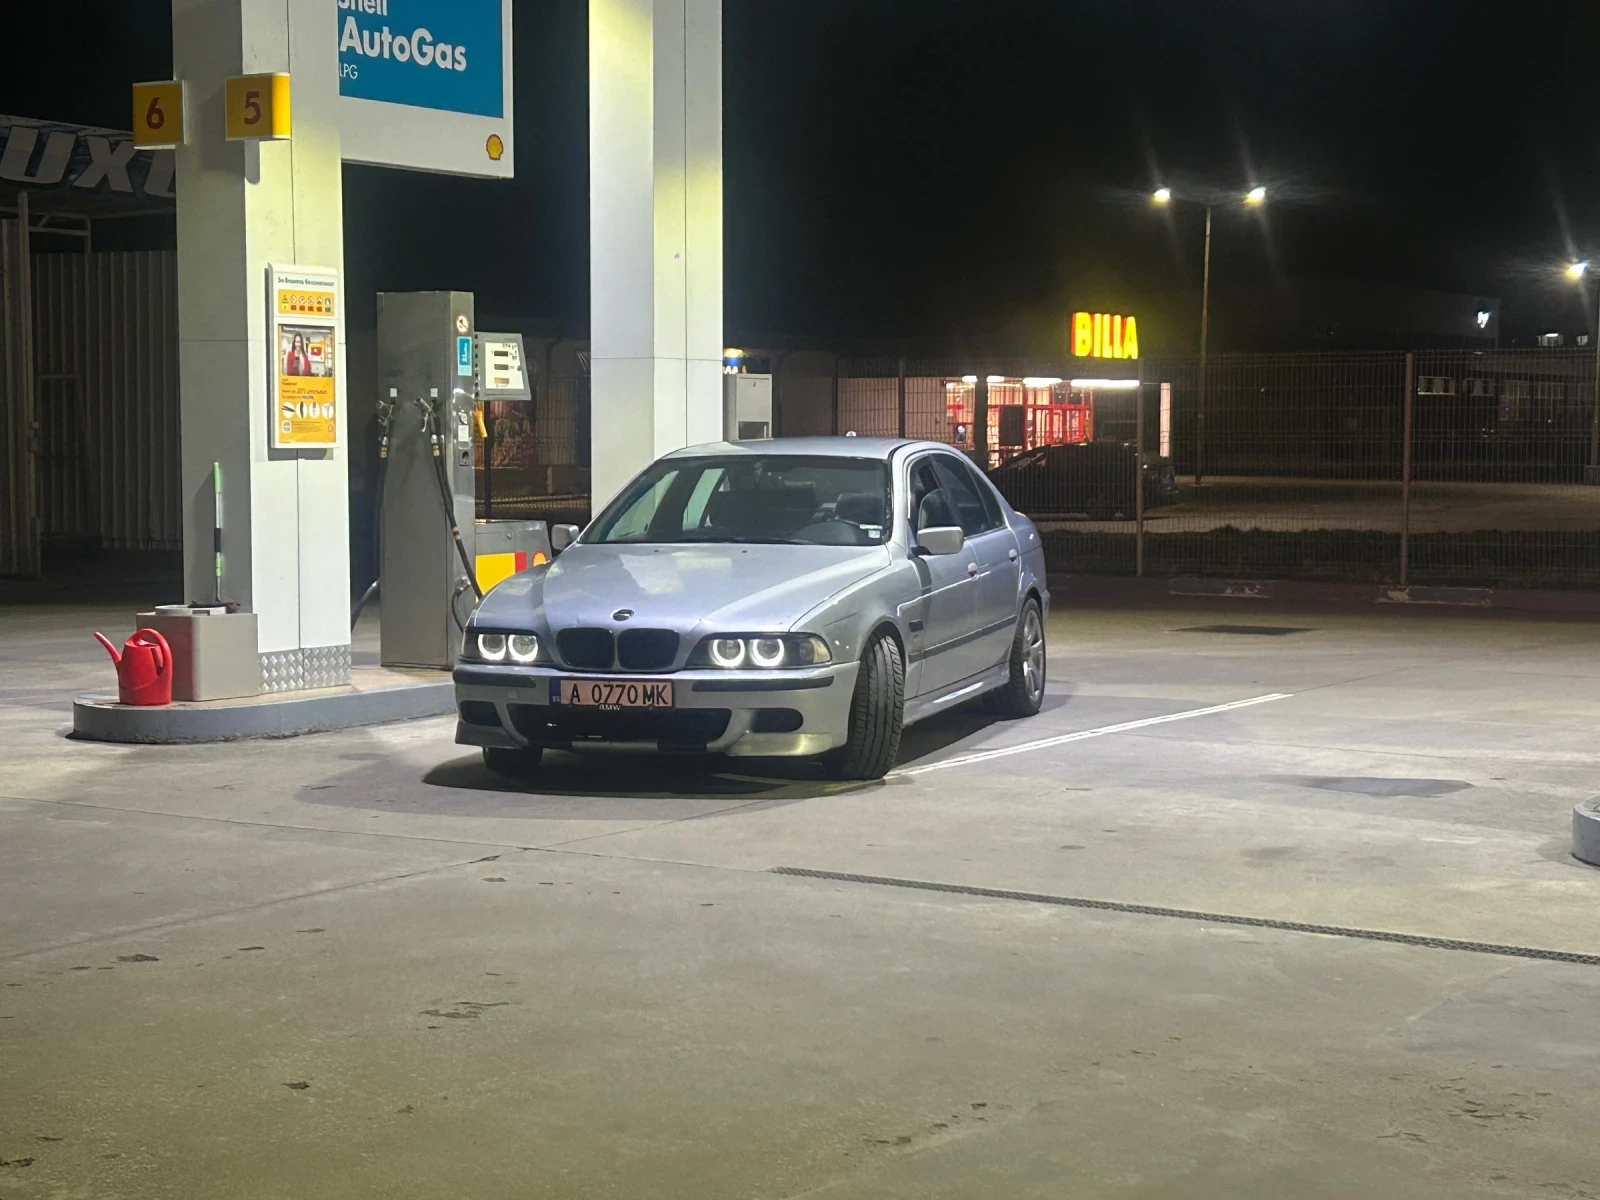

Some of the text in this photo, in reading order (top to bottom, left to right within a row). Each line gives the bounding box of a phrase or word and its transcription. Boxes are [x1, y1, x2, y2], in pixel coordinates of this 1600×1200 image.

[340, 16, 467, 72] AutoGas
[339, 62, 359, 80] LPG
[146, 97, 165, 130] 6
[243, 91, 262, 125] 5
[1071, 311, 1139, 360] BILLA
[591, 683, 639, 705] 0770
[642, 684, 669, 706] MK
